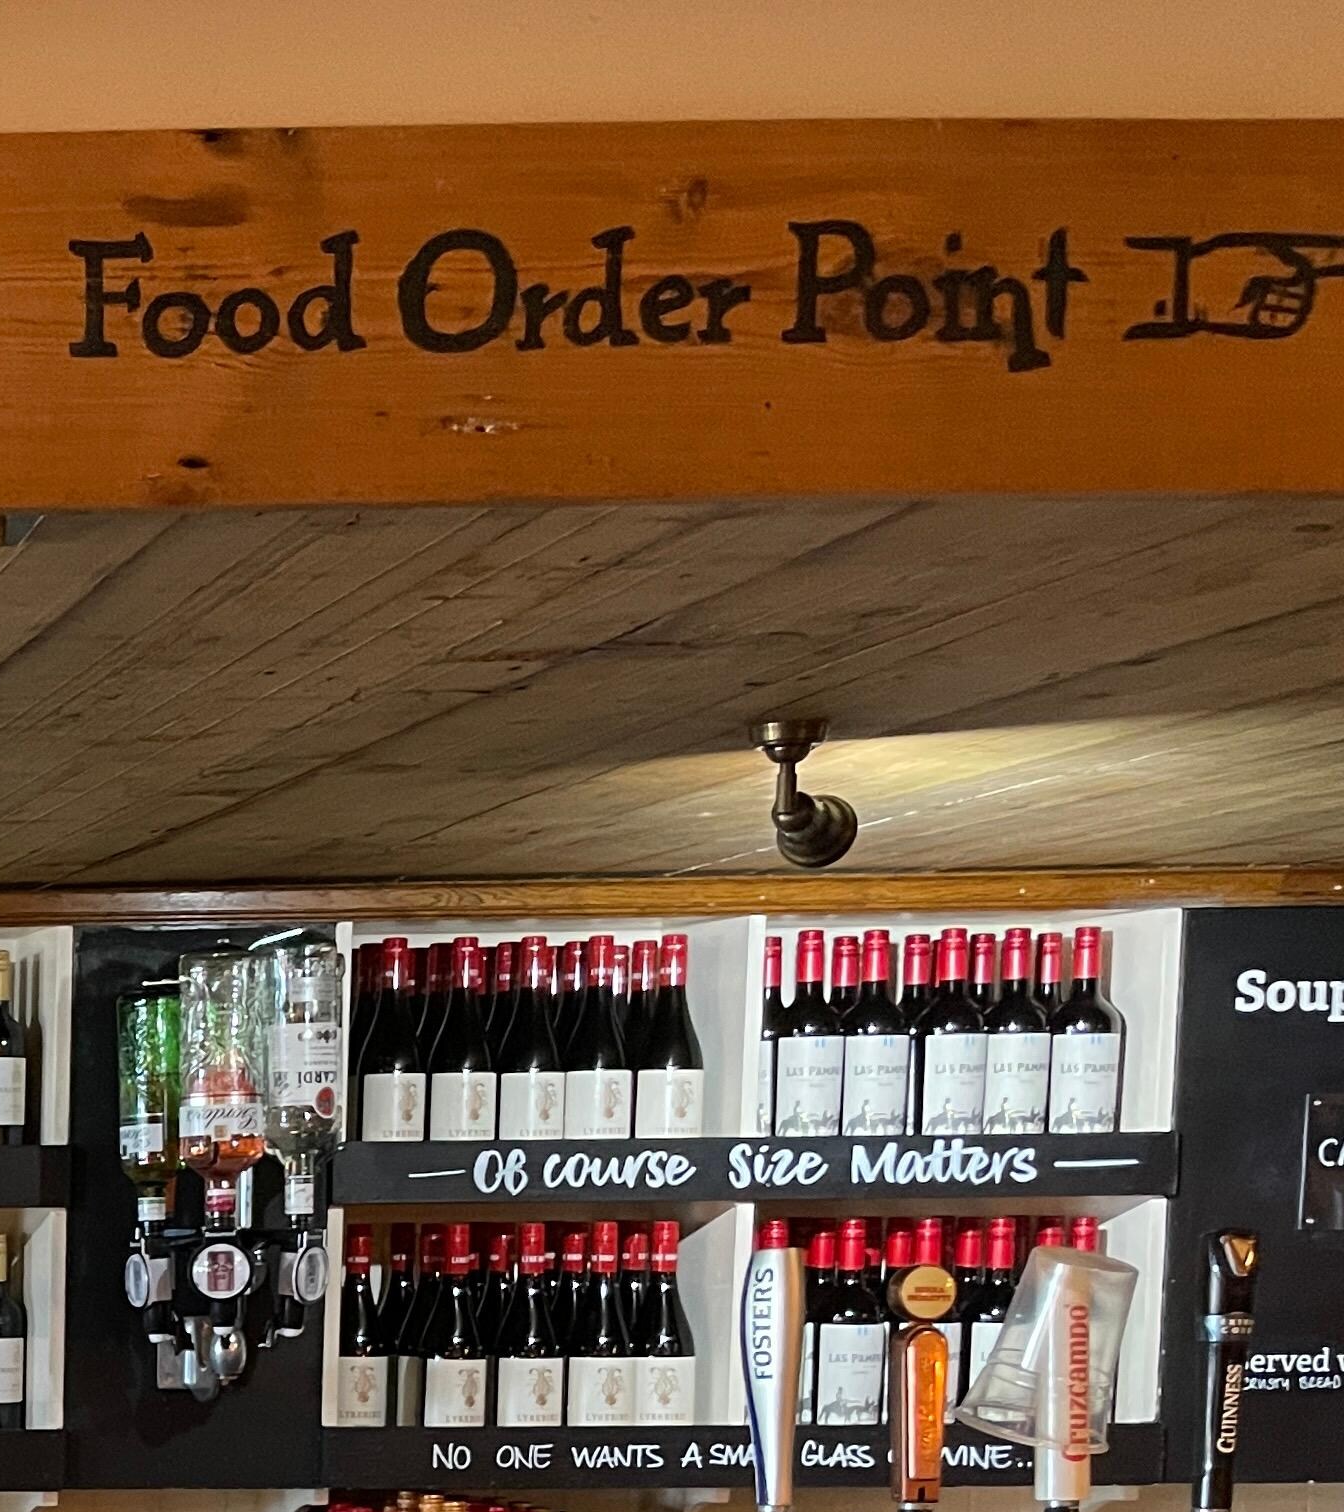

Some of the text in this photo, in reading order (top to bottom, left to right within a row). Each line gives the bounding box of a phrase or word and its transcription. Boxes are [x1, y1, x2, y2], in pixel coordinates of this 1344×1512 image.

[66, 220, 1088, 373] Food Order Point
[728, 1142, 829, 1188] Size
[849, 1138, 1038, 1187] Matters
[754, 1267, 775, 1380] FOSTER'S
[1244, 1346, 1330, 1373] erved
[1216, 1364, 1243, 1454] GUINNESS
[431, 1442, 472, 1470] NO
[495, 1443, 555, 1470] ONE
[570, 1444, 664, 1469] WANTS
[680, 1442, 702, 1469] A
[708, 1443, 757, 1469] SMA
[800, 1441, 876, 1469] GLASS
